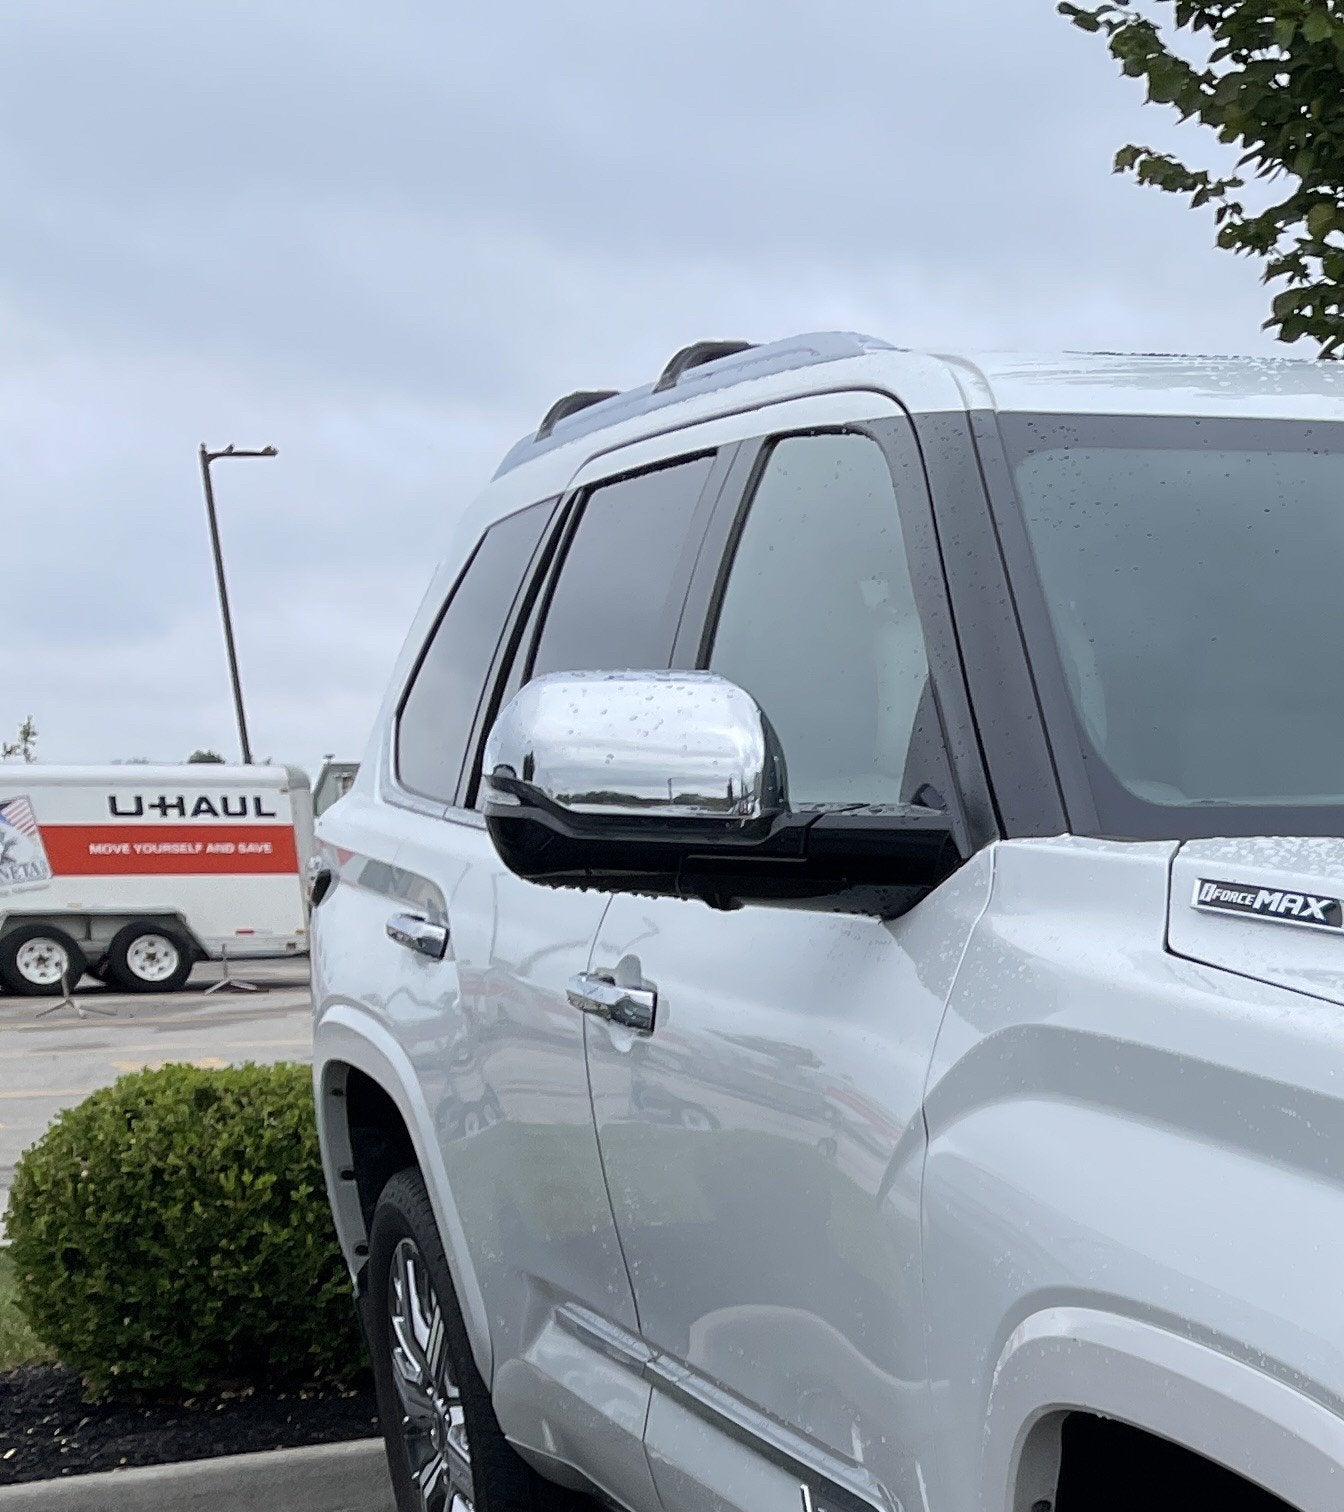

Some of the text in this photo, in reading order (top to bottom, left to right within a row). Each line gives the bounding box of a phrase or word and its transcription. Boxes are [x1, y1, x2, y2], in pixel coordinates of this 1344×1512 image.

[108, 795, 276, 818] U-HAUL
[89, 842, 272, 855] MOVE YOURSELF AND SAVE
